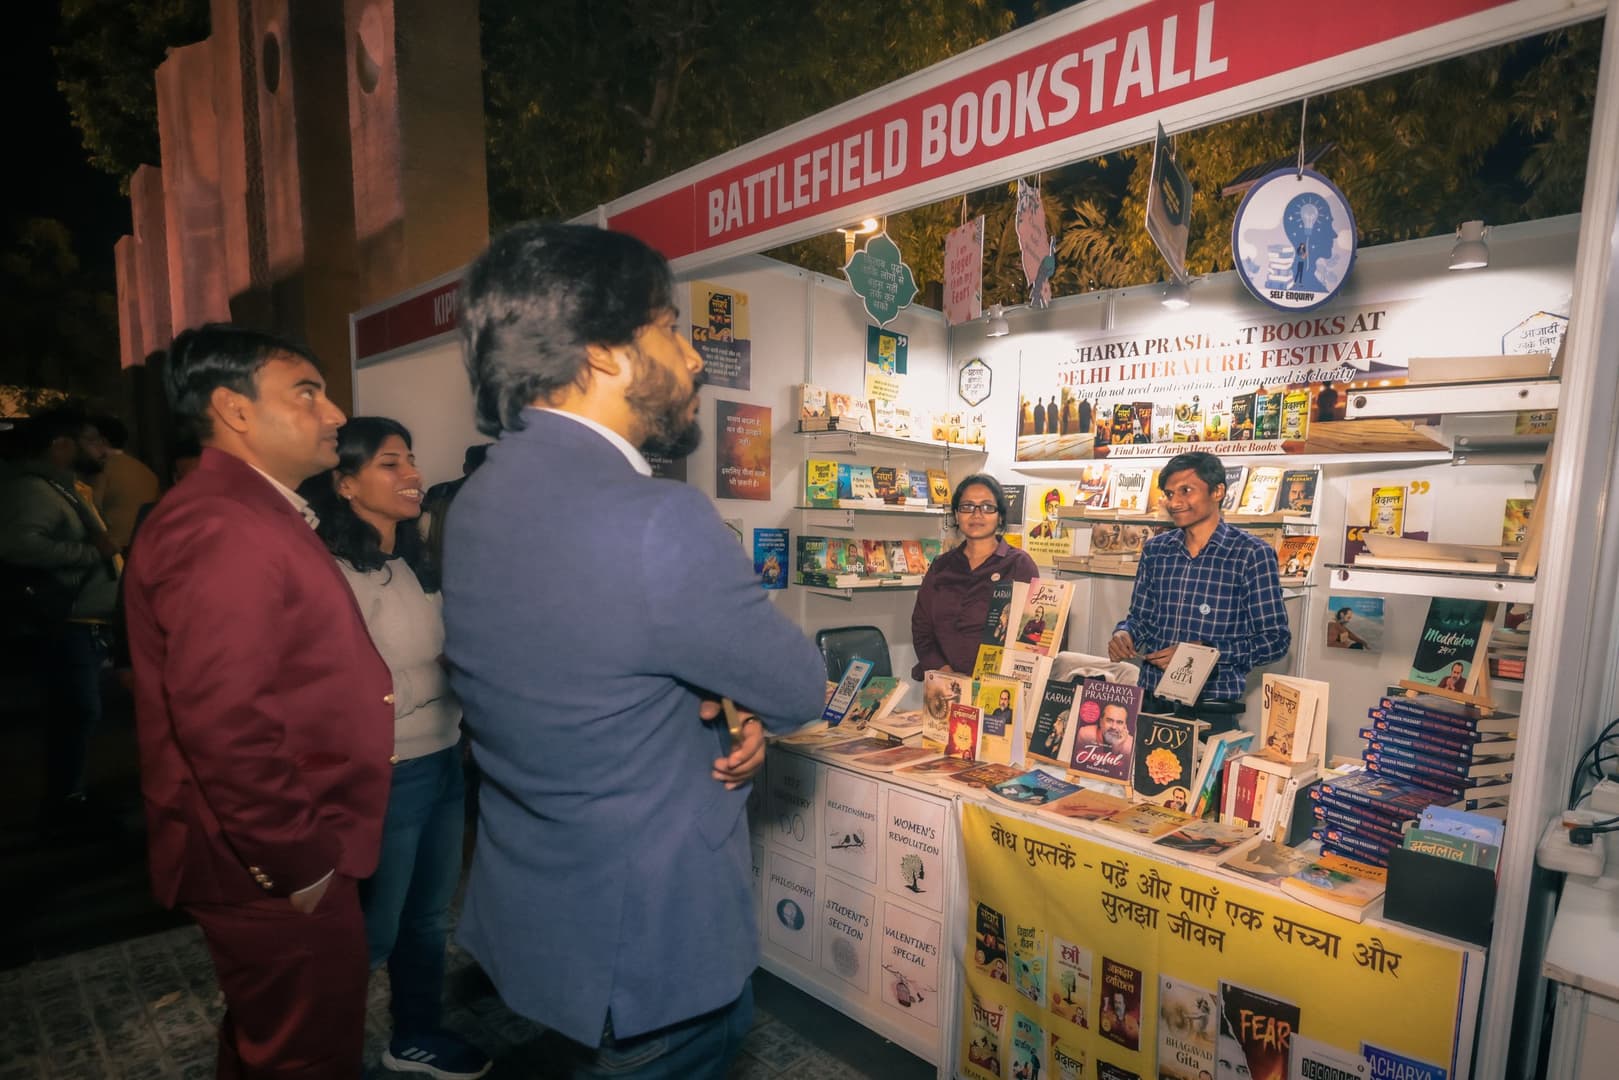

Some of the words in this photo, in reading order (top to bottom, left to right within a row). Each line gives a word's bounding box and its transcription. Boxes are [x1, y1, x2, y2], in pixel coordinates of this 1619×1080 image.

[707, 120, 907, 238] BATTLEFIELD
[921, 1, 1230, 168] BOOKSTALL
[1270, 290, 1284, 300] SELF
[1285, 292, 1315, 302] ENQUIRY
[1058, 341, 1139, 365] HARYA
[1144, 326, 1258, 355] PRASHT
[1262, 315, 1346, 343] BOOKS
[1350, 311, 1386, 333] AT
[1119, 352, 1251, 382] LITERATURE
[1261, 339, 1382, 368] FESTIVAL
[1077, 388, 1094, 400] You
[1095, 386, 1106, 399] do
[1108, 386, 1125, 397] not
[1127, 383, 1151, 395] need
[1238, 377, 1262, 391] you
[1264, 371, 1293, 385] need
[1295, 371, 1307, 383] is
[1308, 366, 1357, 384] clarity
[1114, 445, 1135, 456] Find
[1136, 445, 1157, 455] Your
[1157, 444, 1189, 456] Clarity
[1215, 443, 1230, 453] Get
[1231, 442, 1247, 452] the
[1248, 441, 1277, 452] Books
[1118, 473, 1146, 492] Stupidity
[1424, 628, 1475, 649] Meditation
[1088, 682, 1133, 697] ACHARYA
[1170, 671, 1193, 684] GITA
[1045, 691, 1072, 704] KARMA
[1085, 690, 1137, 705] PRASHANT
[1144, 724, 1188, 749] JOY
[1076, 744, 1123, 767] Joyful
[827, 800, 876, 822] RELATIONSHIPS
[893, 815, 936, 840] WOMEN'S
[888, 831, 940, 856] REVOLUTION
[771, 873, 814, 897] PHILOSOPHY
[990, 822, 1017, 852] बोध
[1023, 837, 1077, 870] पुस्तकें
[1136, 869, 1172, 903] और
[1225, 900, 1264, 930] एक
[1352, 937, 1402, 979] और
[826, 900, 869, 927] STUDENT'S
[1101, 891, 1159, 930] सुलझा
[1167, 910, 1226, 953] जीवन
[828, 917, 864, 941] SECTION
[885, 927, 937, 956] VALENTINE'S
[892, 945, 926, 967] SPECIAL
[1060, 943, 1081, 965] स्त्री
[1240, 1009, 1292, 1052] FEAR
[1166, 1036, 1213, 1062] BHAGAVAD
[1176, 1051, 1199, 1070] Gita
[1302, 1057, 1361, 1080] DECOD
